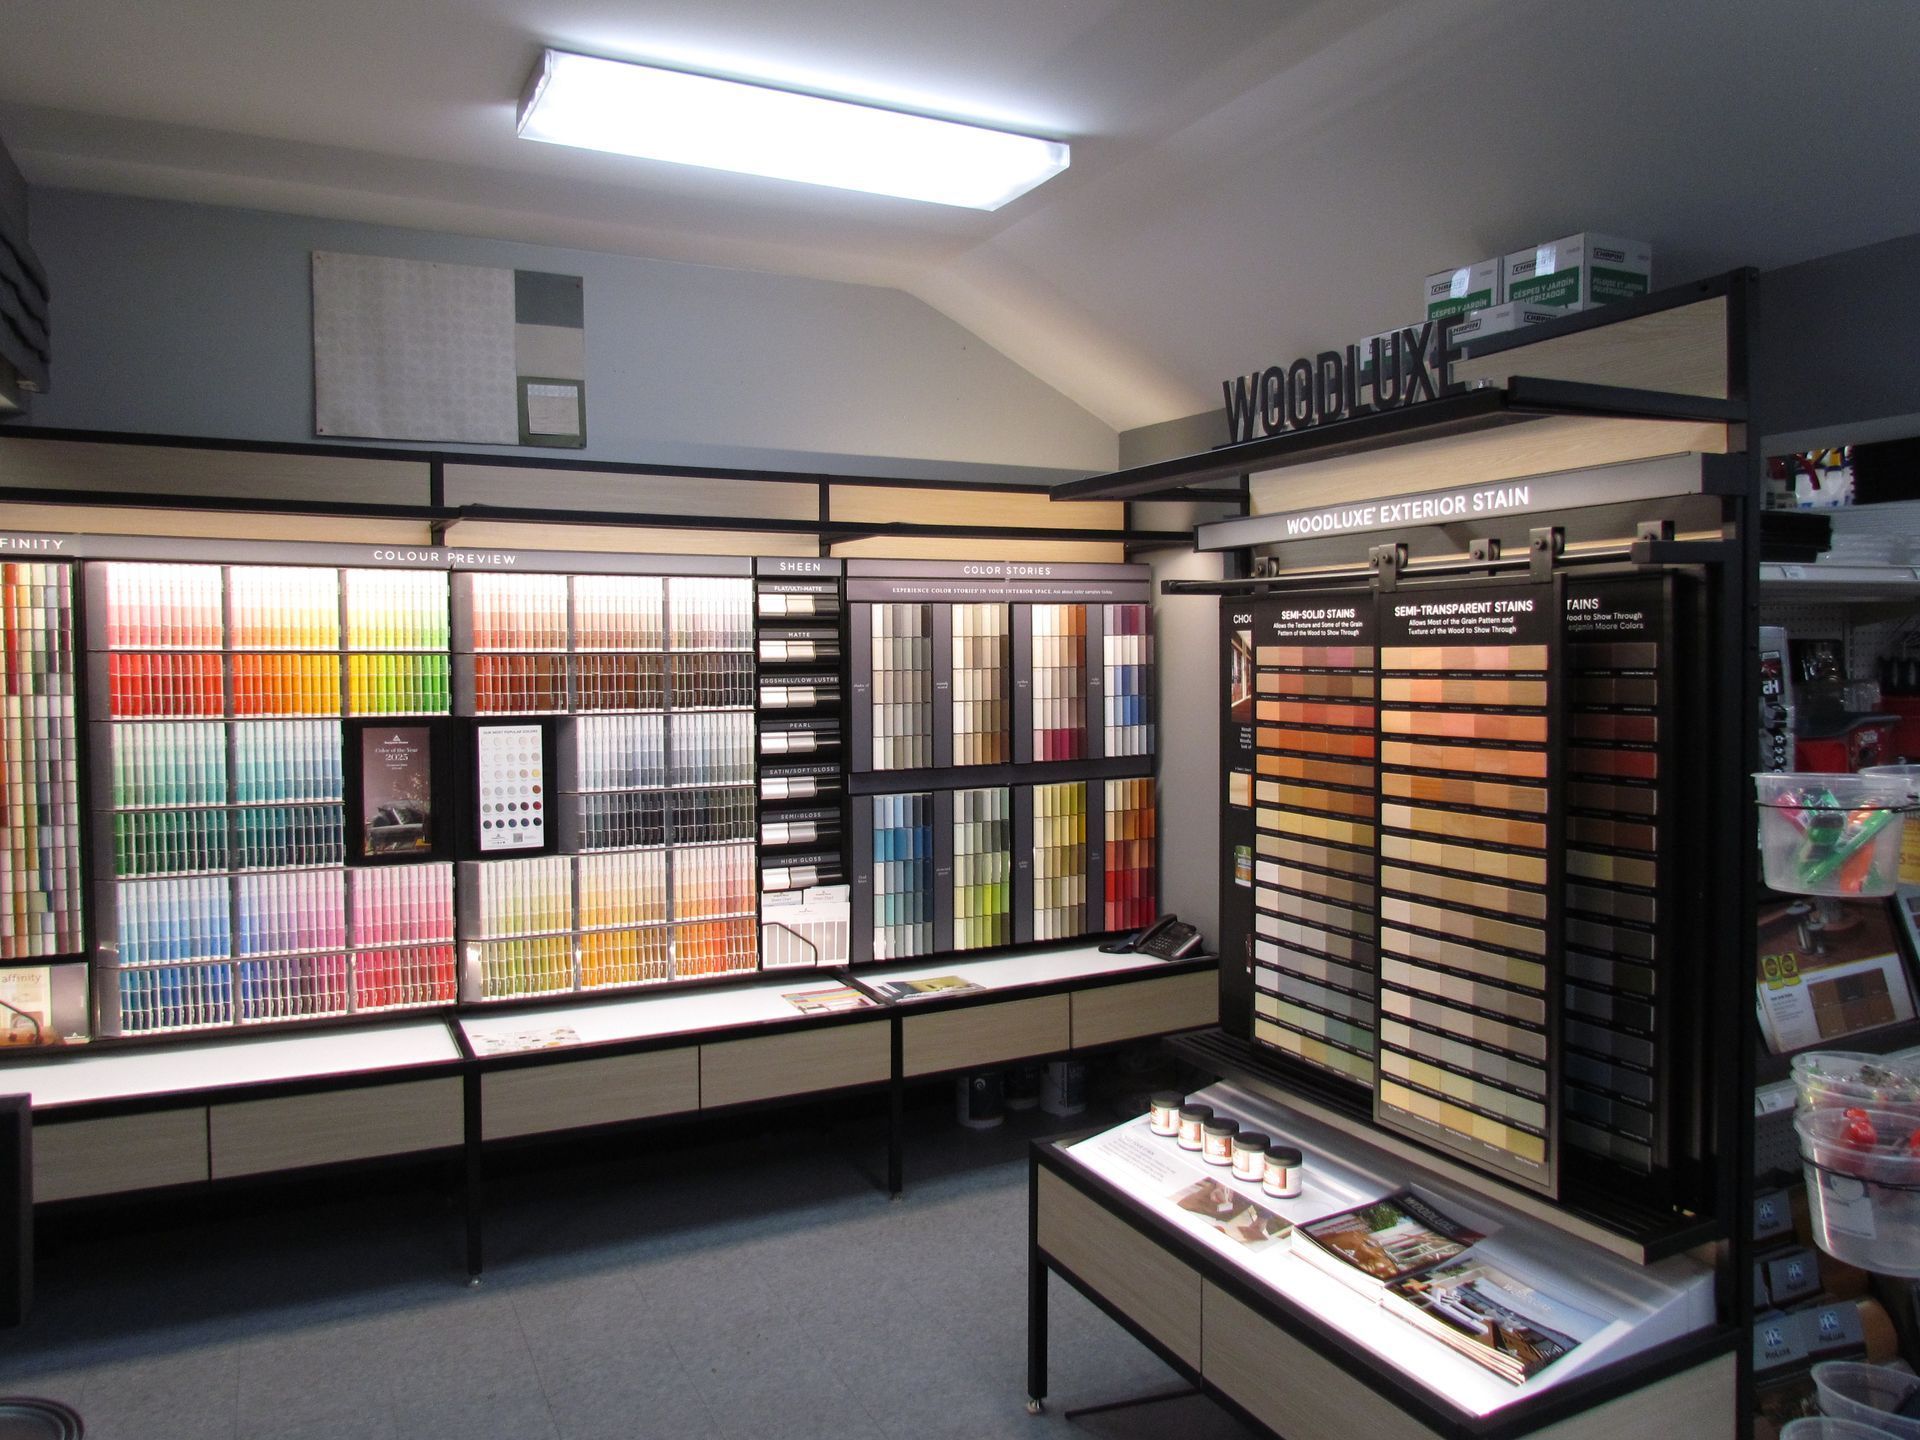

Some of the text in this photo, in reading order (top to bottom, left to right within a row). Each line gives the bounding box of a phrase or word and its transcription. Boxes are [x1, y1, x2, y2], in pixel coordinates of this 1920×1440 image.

[1452, 322, 1480, 334] HAPIN
[1223, 313, 1467, 443] WOODLUXE
[1381, 495, 1466, 524] EXTERIOR
[1473, 486, 1530, 512] STAIN
[373, 550, 517, 565] COLOUR PREVIEW
[780, 561, 822, 572] SHEEN
[963, 565, 1001, 575] COLOR
[1281, 608, 1356, 620] SEMI-SOLID STAINS
[1394, 600, 1534, 617] SEMI-TRANSPARENT STAINS
[1427, 618, 1441, 626] Most
[1461, 617, 1477, 625] Grain
[1501, 616, 1514, 624] and
[1613, 612, 1643, 621] Through
[1340, 629, 1359, 637] Through
[1429, 627, 1436, 635] of
[1437, 627, 1447, 635] the
[1473, 626, 1490, 634] Show
[1491, 626, 1517, 635] Through
[385, 753, 409, 761] 2025
[781, 812, 822, 820] SEMI-GLOSS
[2, 973, 41, 984] affinity
